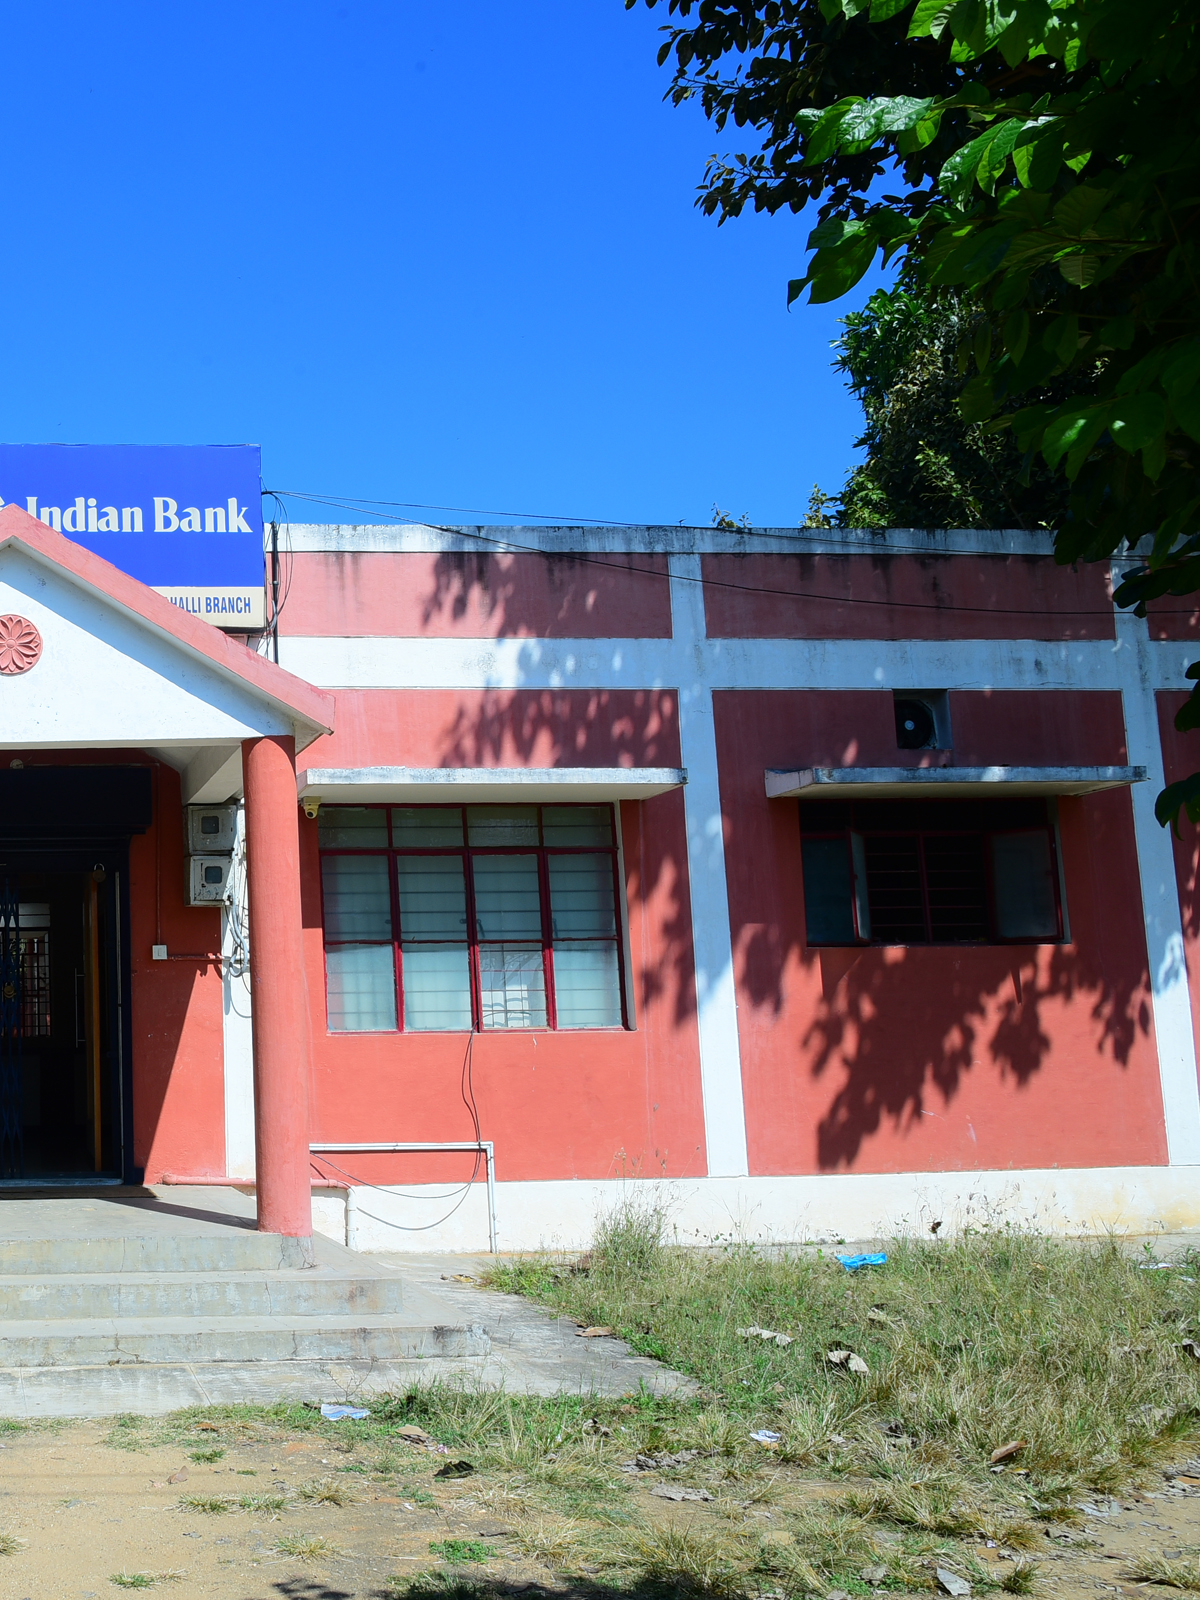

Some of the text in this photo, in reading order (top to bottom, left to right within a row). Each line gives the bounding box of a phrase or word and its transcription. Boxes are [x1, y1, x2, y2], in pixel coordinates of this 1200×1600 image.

[26, 497, 253, 533] Indian Bank
[205, 597, 251, 614] BRANCH
